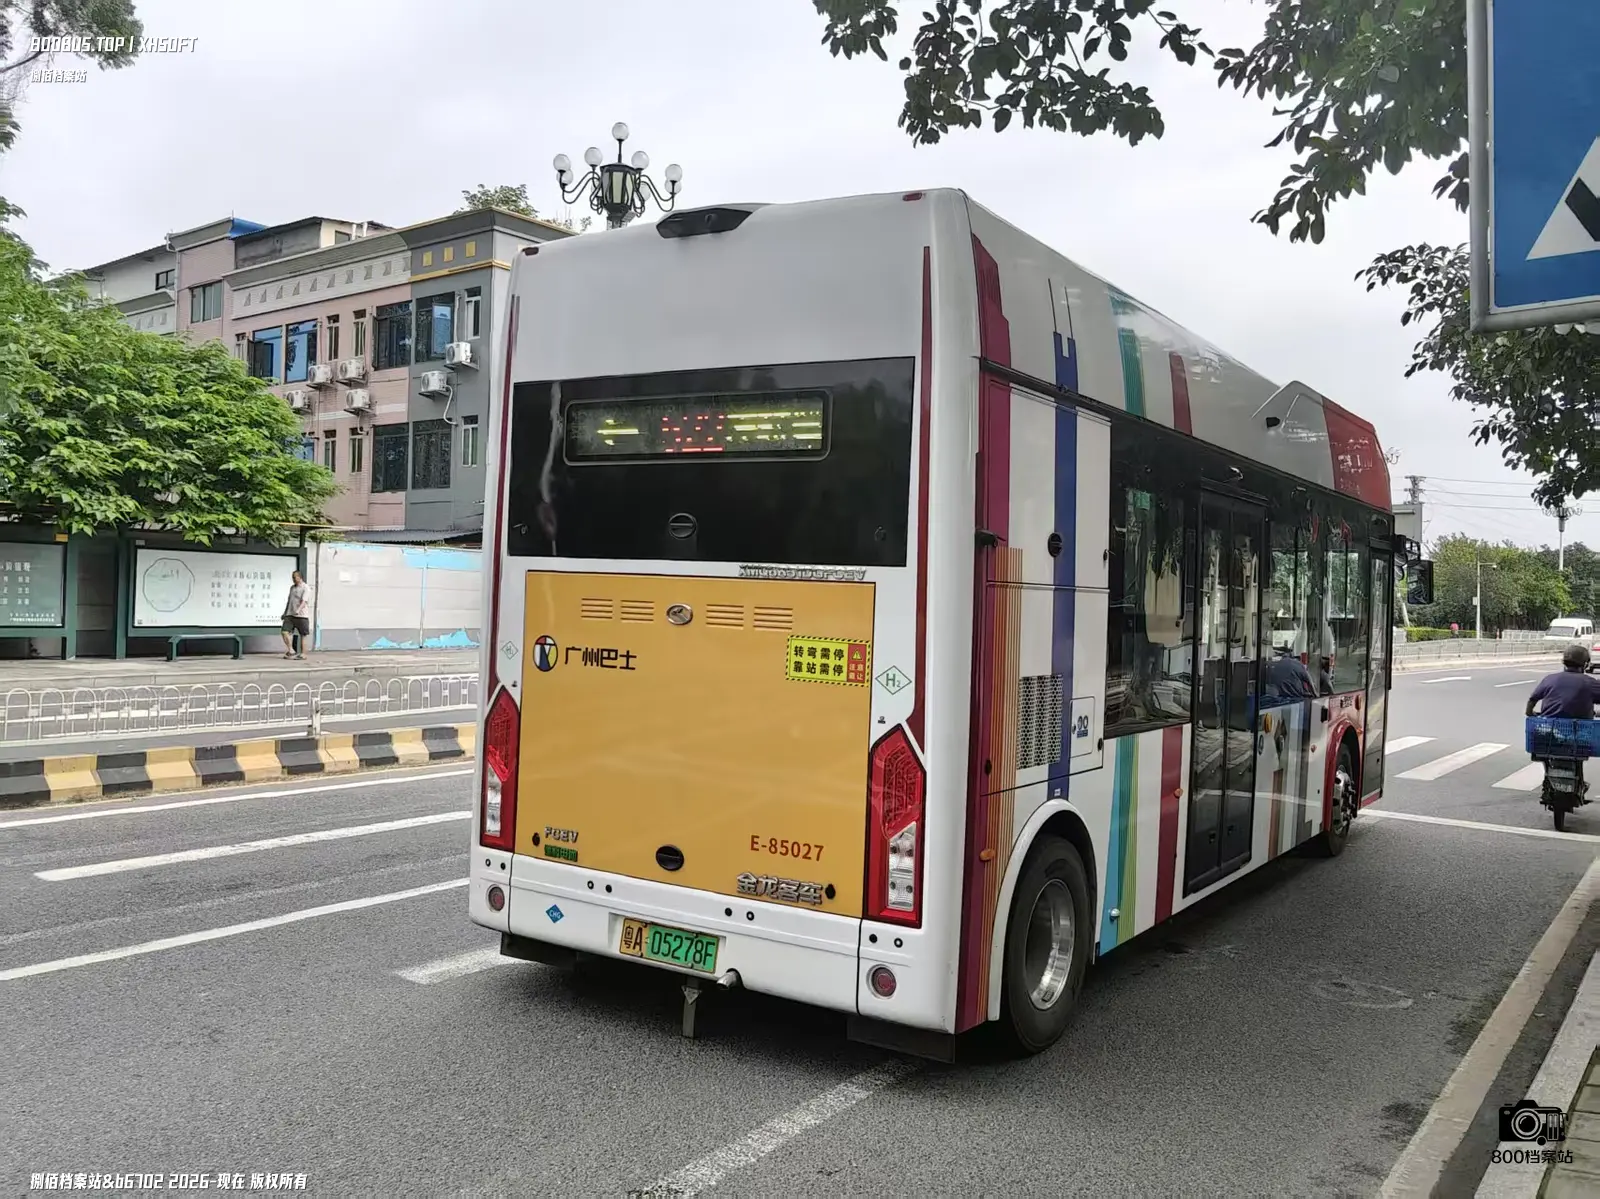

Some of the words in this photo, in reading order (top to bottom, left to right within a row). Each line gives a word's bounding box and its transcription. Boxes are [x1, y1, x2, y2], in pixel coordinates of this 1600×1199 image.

[564, 646, 637, 671] 广州巴士
[793, 645, 845, 661] 转弯需停
[793, 660, 844, 677] 靠站需停
[750, 834, 824, 862] E-85027
[736, 871, 824, 906] 金龙客车
